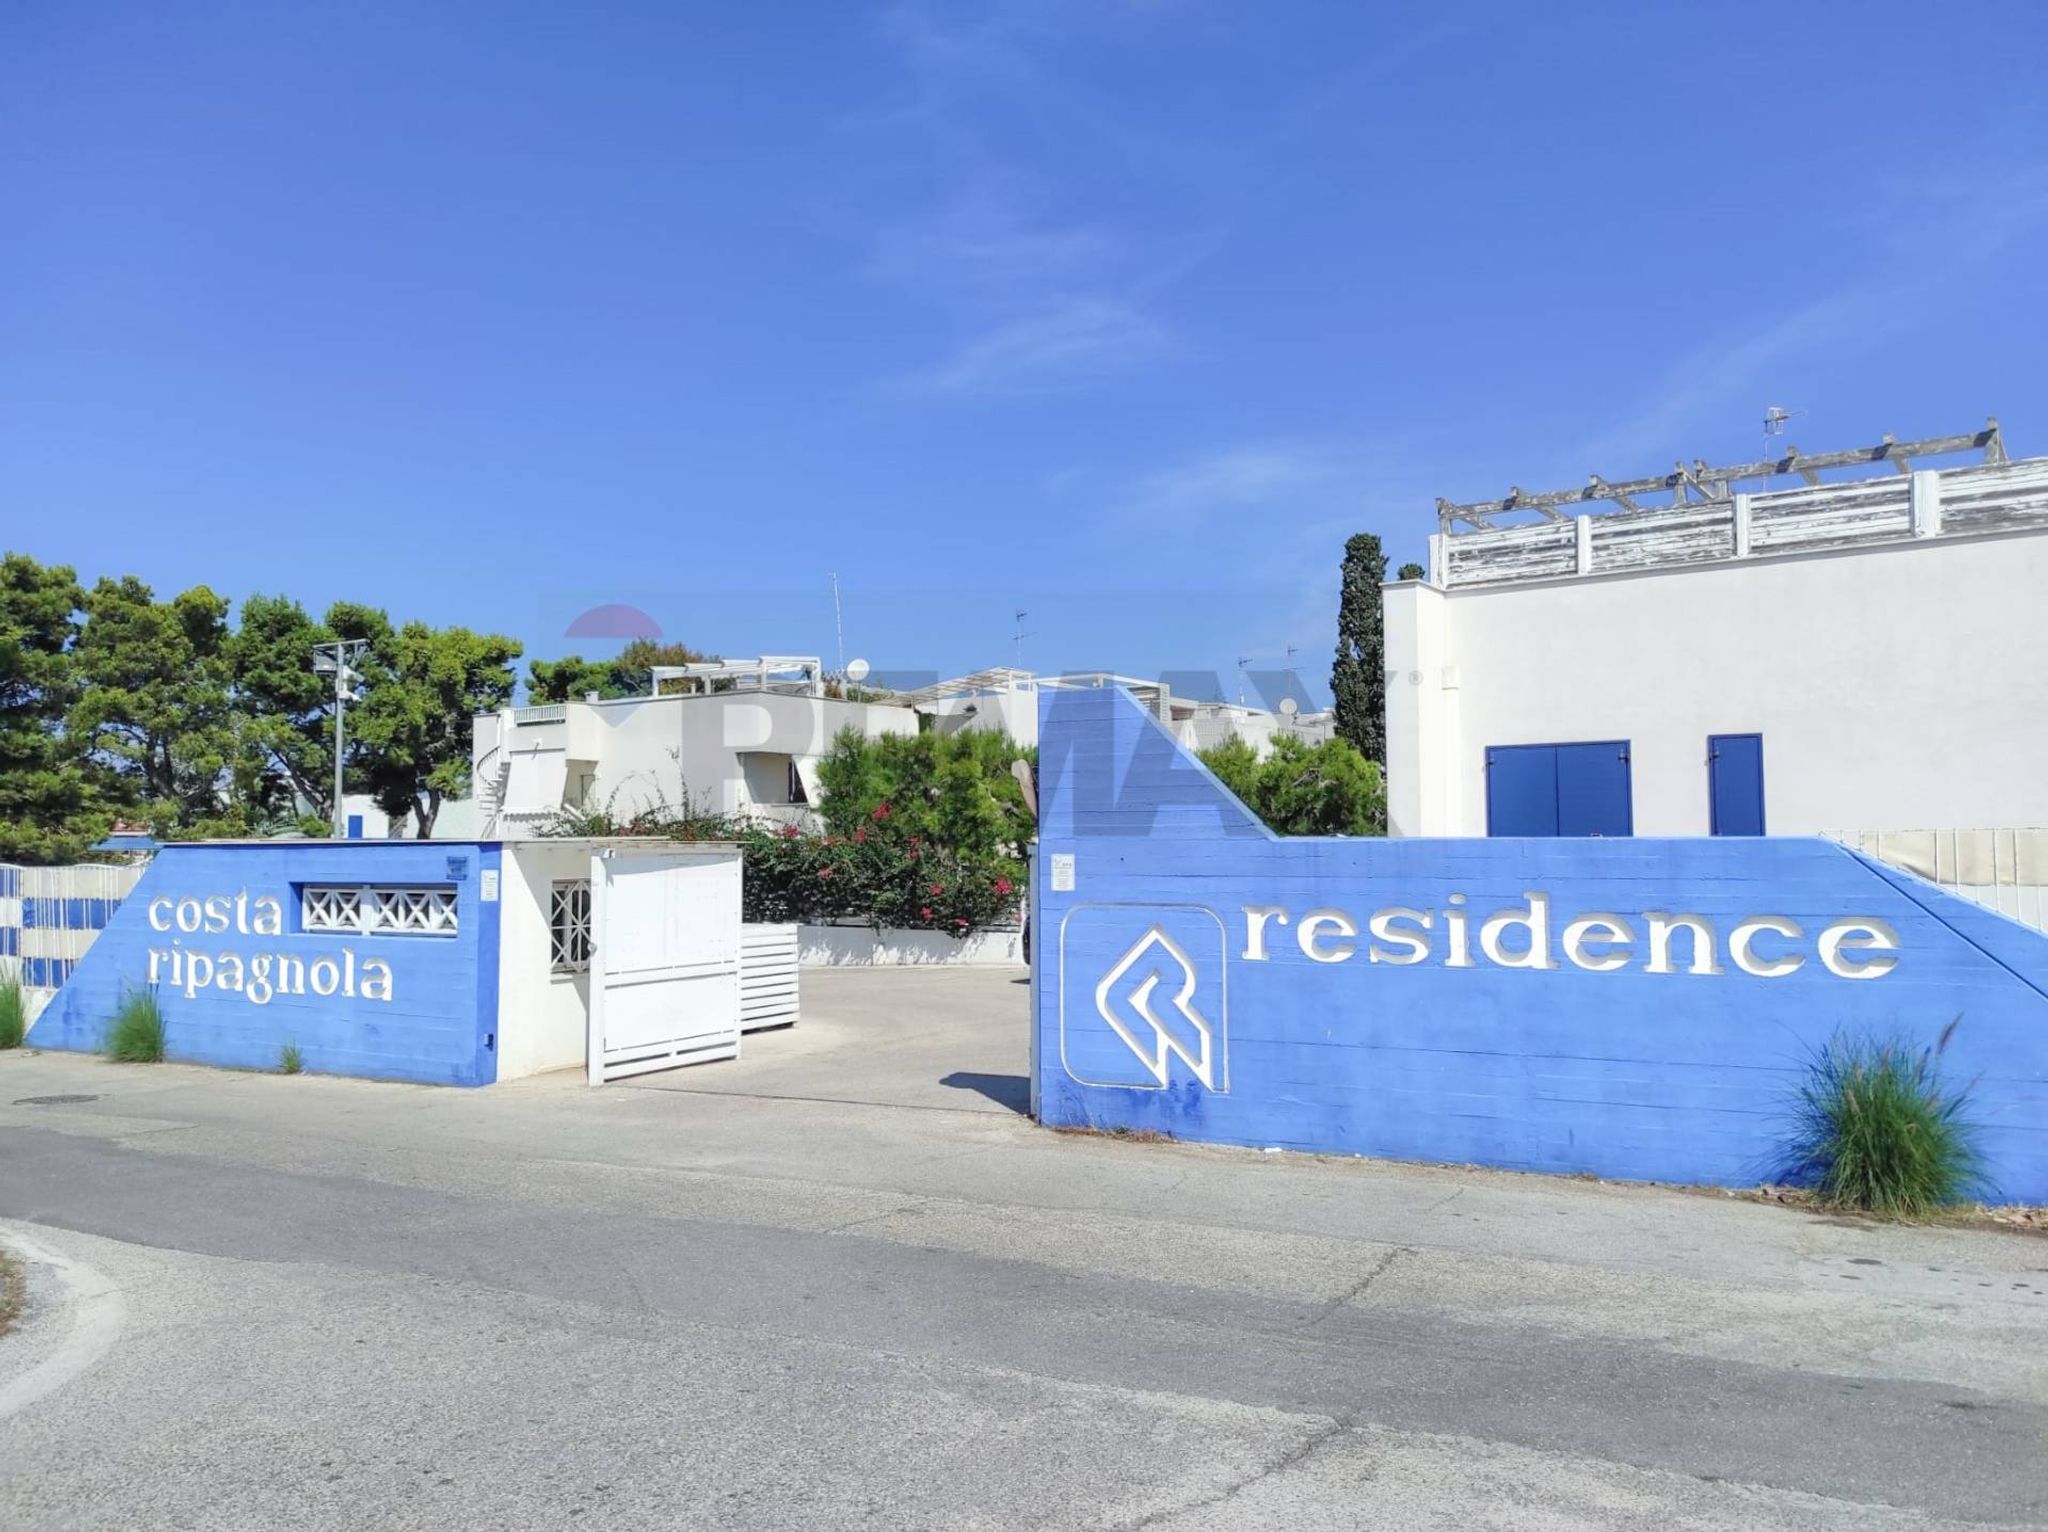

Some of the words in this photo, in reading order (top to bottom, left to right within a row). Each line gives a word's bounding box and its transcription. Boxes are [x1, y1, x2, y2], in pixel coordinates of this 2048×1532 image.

[148, 886, 282, 936] costa
[1241, 892, 1899, 979] residence
[148, 939, 393, 1005] ripagnola
